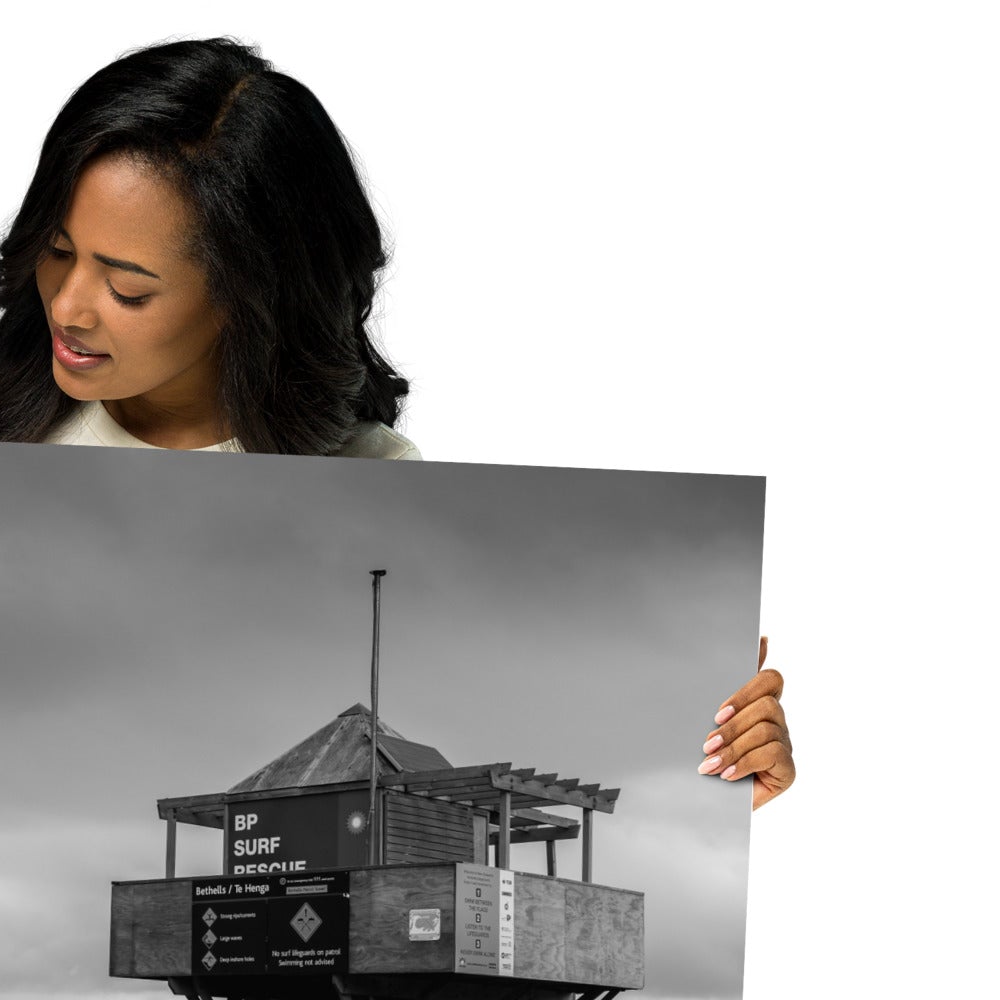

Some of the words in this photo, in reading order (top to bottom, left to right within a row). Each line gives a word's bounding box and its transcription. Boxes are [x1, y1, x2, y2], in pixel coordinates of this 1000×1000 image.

[234, 813, 258, 832] BP
[234, 836, 280, 856] SURF
[196, 884, 226, 896] Bethells
[234, 884, 242, 894] Te
[244, 884, 270, 895] Henga
[292, 949, 315, 958] lifeguards
[325, 948, 341, 957] patrol
[278, 959, 303, 967] Swimming
[315, 958, 334, 966] advised
